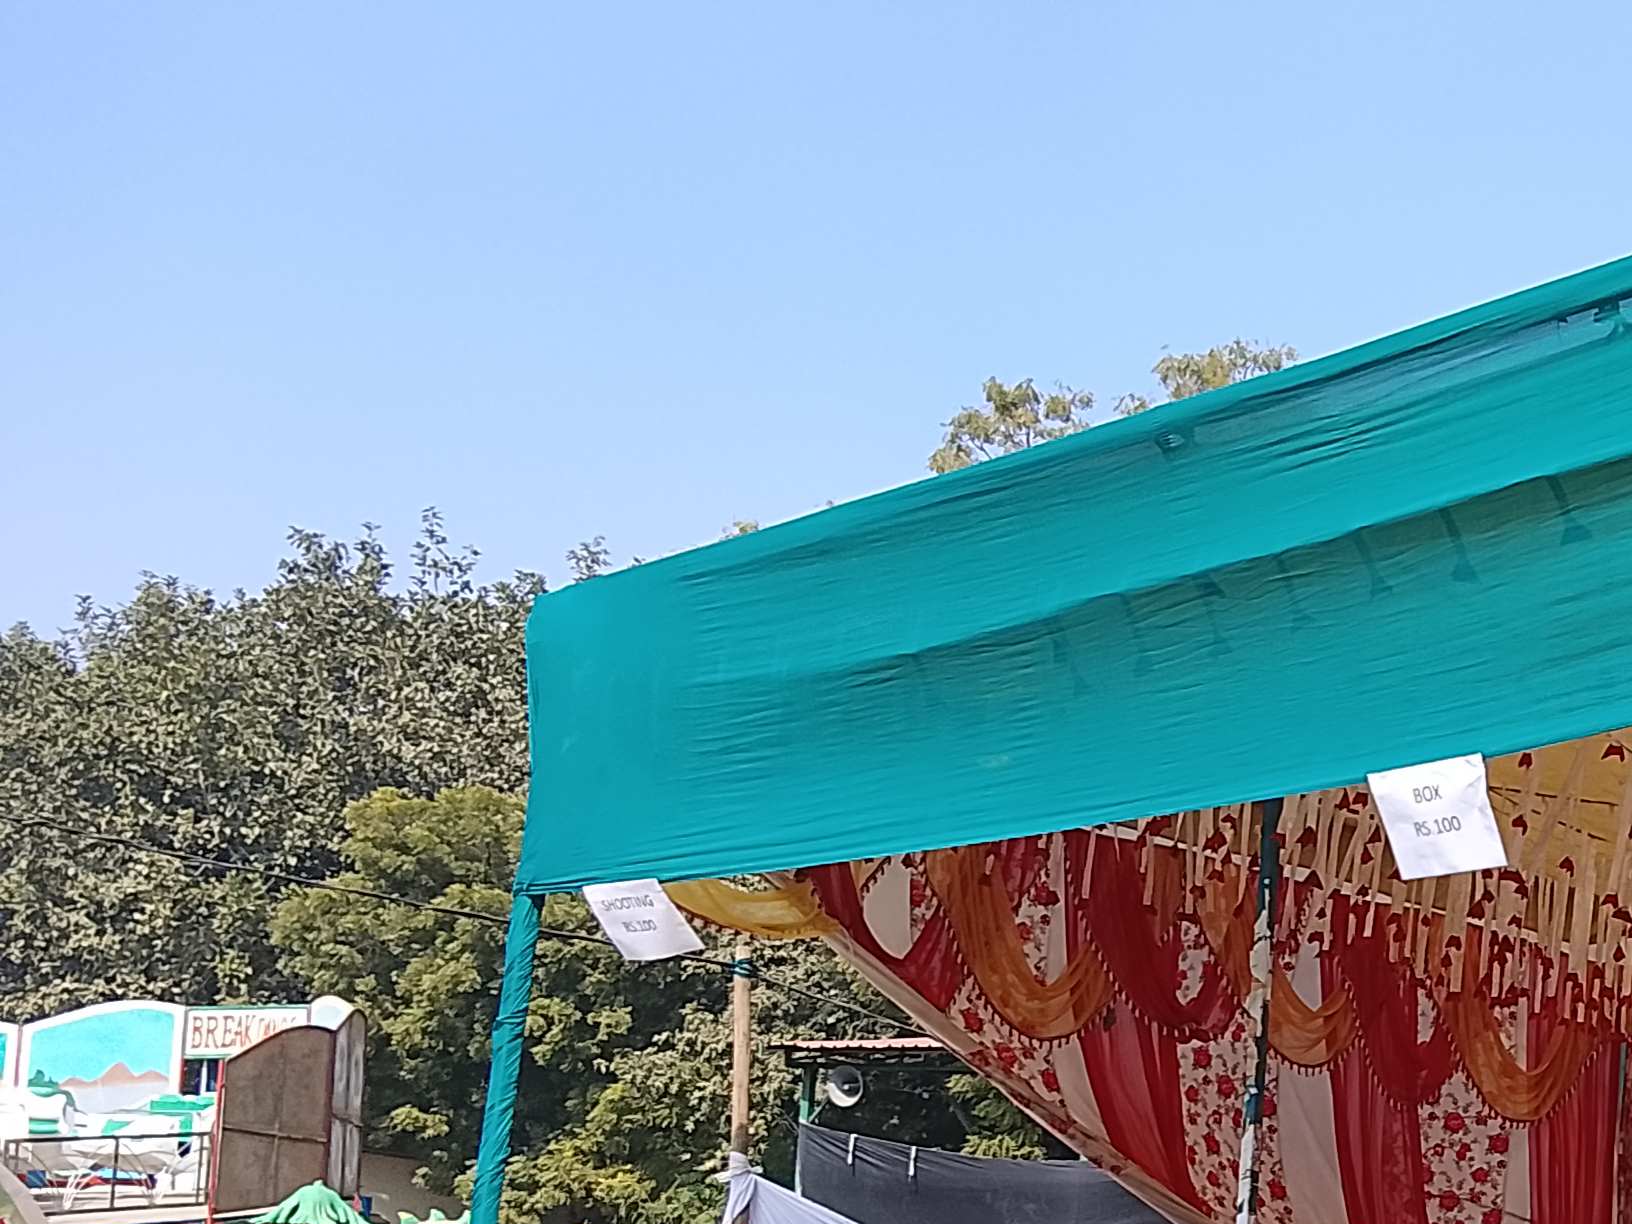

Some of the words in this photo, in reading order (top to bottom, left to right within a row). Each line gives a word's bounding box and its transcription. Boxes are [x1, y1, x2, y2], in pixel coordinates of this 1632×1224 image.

[1412, 784, 1443, 803] BOX
[600, 894, 655, 912] SHOOTING
[191, 1014, 256, 1050] BREAK
